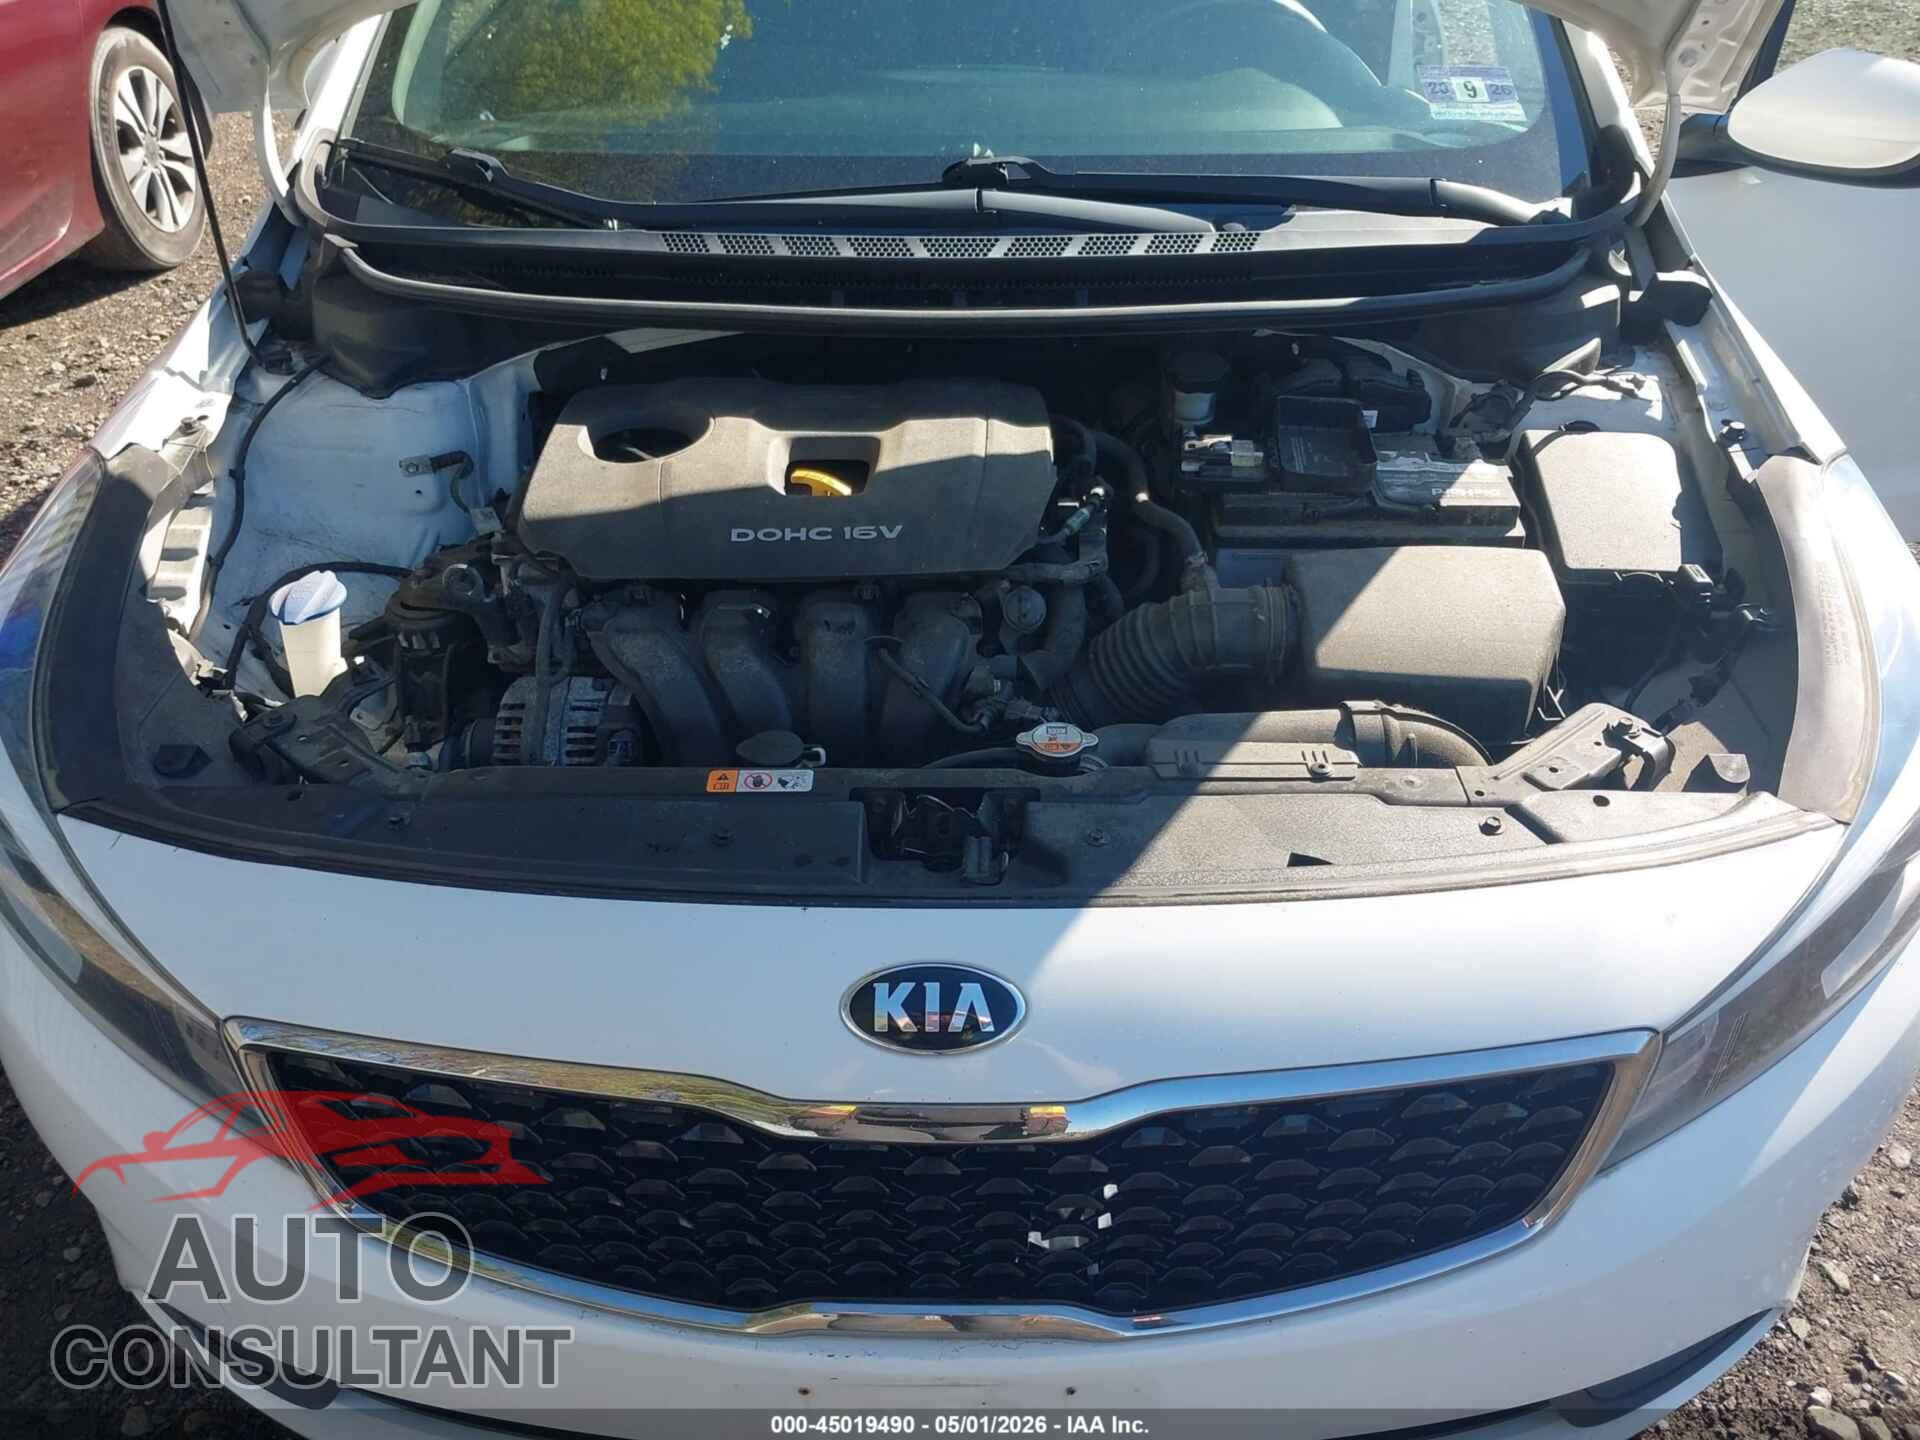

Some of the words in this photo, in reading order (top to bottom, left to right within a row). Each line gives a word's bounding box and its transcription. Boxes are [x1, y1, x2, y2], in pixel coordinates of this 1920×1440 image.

[1463, 80, 1477, 98] 9
[731, 527, 833, 542] DOHC
[843, 525, 903, 540] 16V
[872, 982, 995, 1032] KIA
